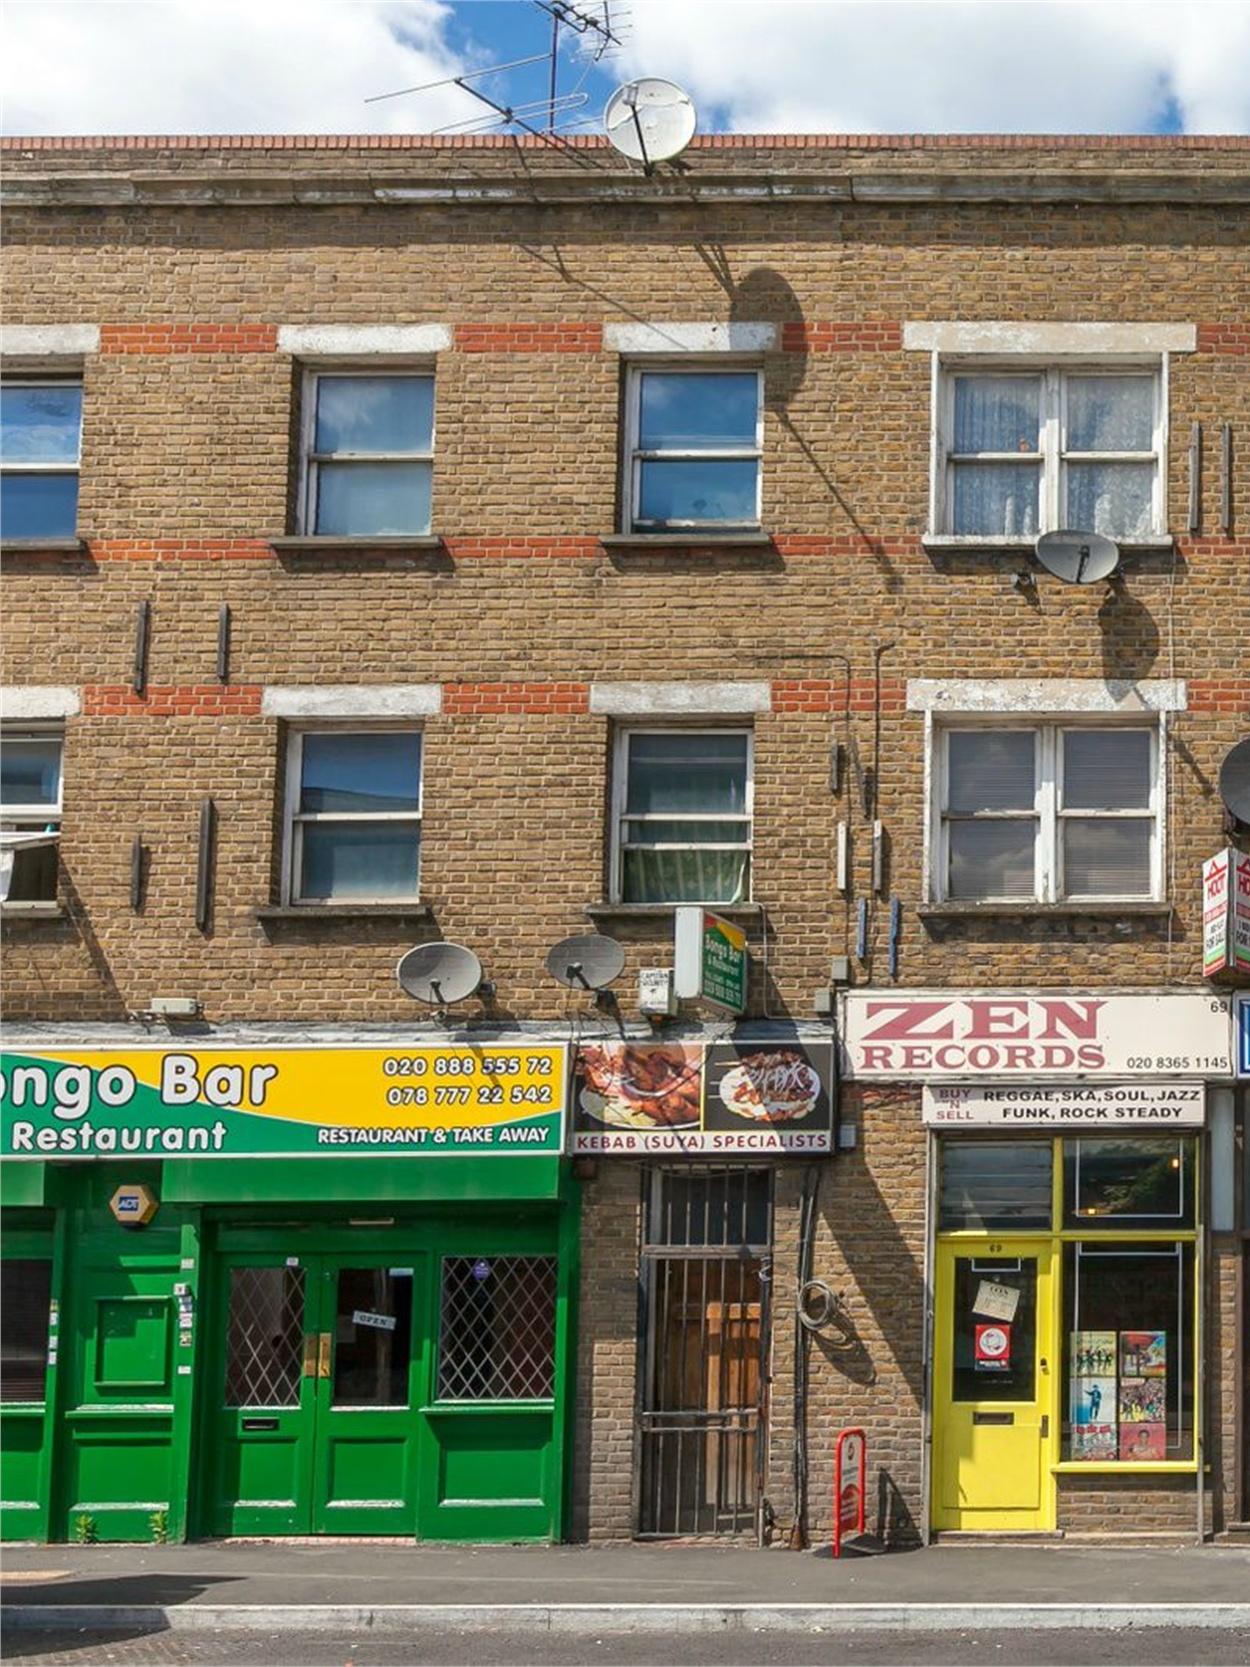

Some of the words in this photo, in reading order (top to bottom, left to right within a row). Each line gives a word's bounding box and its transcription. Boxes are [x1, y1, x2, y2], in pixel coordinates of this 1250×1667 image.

[1210, 1001, 1228, 1013] 69
[860, 1000, 1109, 1041] ZEN
[383, 1056, 427, 1076] 020
[434, 1056, 475, 1076] 888
[481, 1055, 520, 1075] 555
[526, 1055, 552, 1075] 72
[859, 1044, 1106, 1070] RECORDS
[1126, 1056, 1153, 1070] 020
[1156, 1056, 1191, 1070] 8365
[1195, 1056, 1229, 1069] 1145
[0, 1062, 137, 1121] ngo
[159, 1053, 277, 1107] Bar
[386, 1086, 428, 1106] 078
[434, 1086, 470, 1106] 777
[478, 1085, 504, 1105] 22
[510, 1085, 552, 1105] 542
[939, 1089, 971, 1099] BUY
[1156, 1090, 1201, 1101] JAZZ
[936, 1110, 974, 1121] SELL
[1002, 1107, 1055, 1120] FUNK,
[1060, 1107, 1109, 1119] ROCK
[1115, 1107, 1183, 1118] STEADY
[10, 1119, 227, 1152] Restaurant
[317, 1127, 429, 1144] RESTAURANT
[432, 1127, 449, 1143] &
[452, 1126, 494, 1143] TAKE
[498, 1126, 550, 1143] AWAY
[577, 1136, 636, 1150] KEBAB
[643, 1134, 705, 1151] (SUYA)
[713, 1134, 828, 1149] SPECIALISTS
